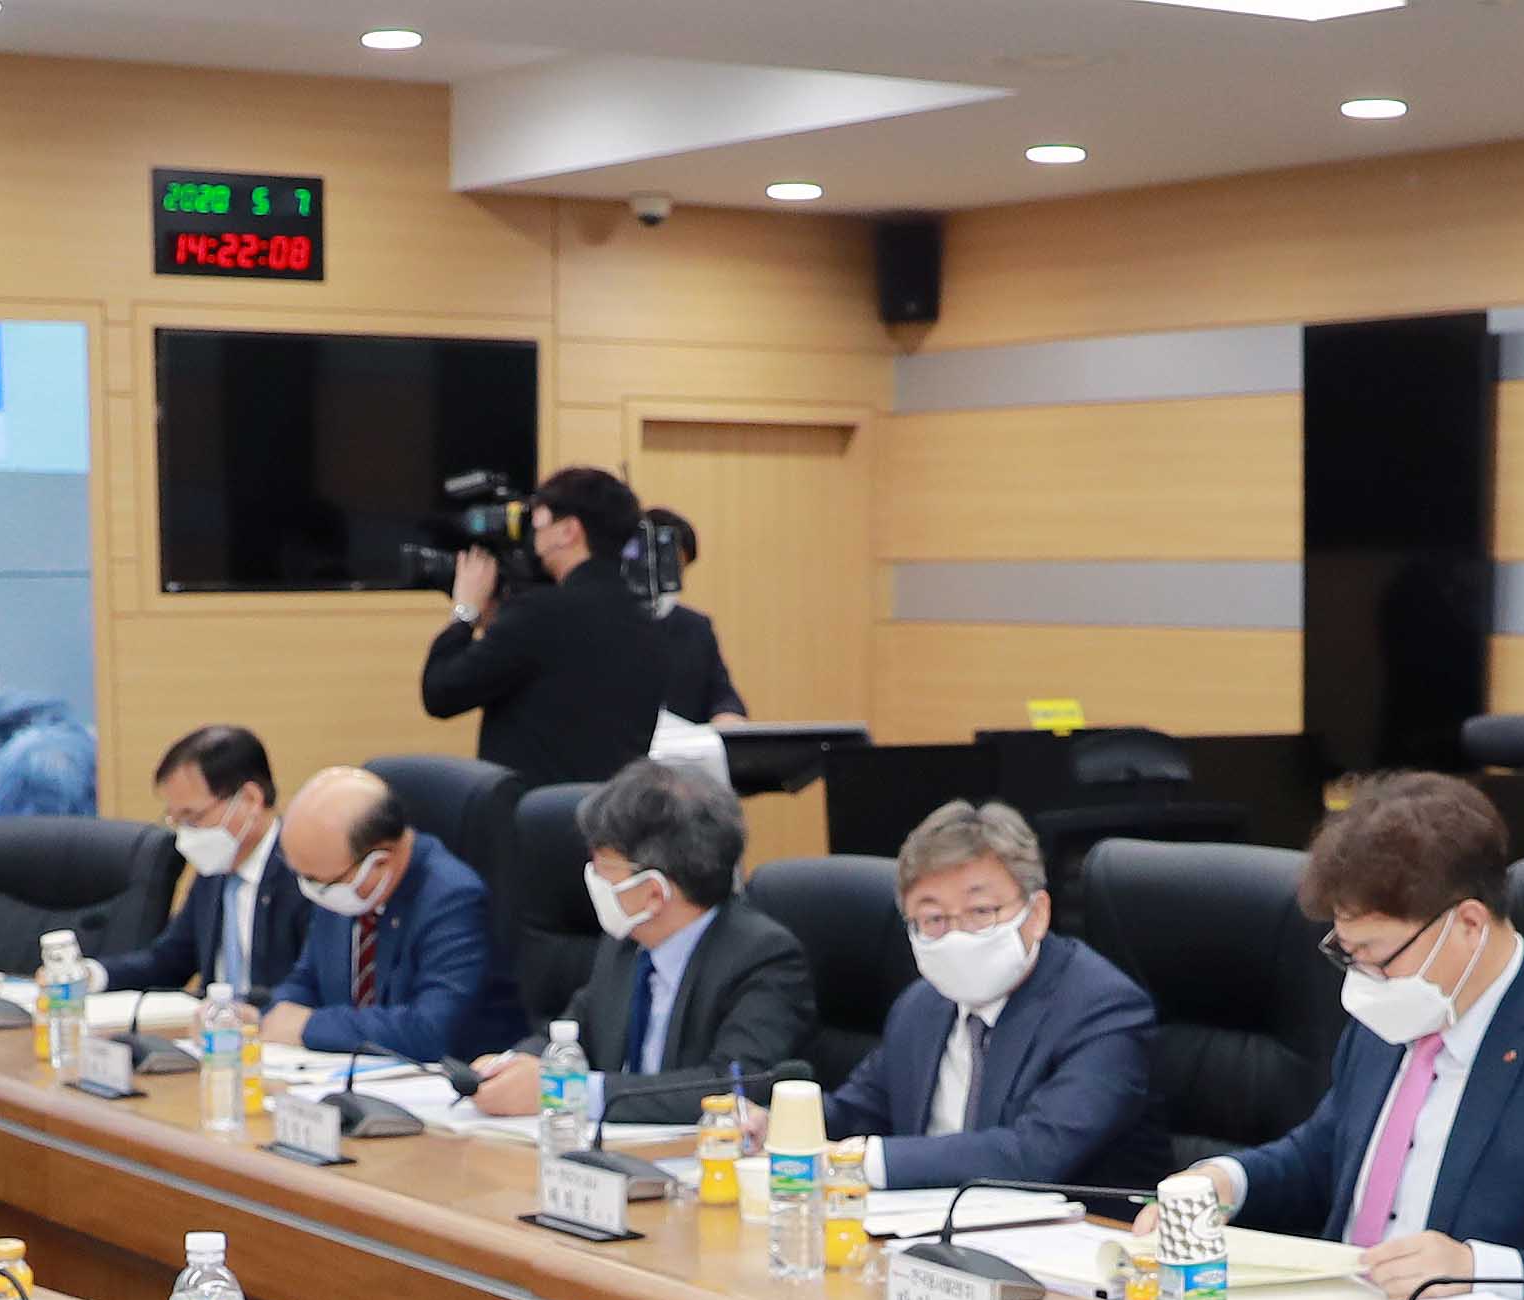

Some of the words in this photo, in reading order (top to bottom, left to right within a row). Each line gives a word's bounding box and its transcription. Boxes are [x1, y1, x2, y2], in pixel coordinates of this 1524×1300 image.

[251, 185, 270, 216] 5
[293, 187, 312, 217] 7
[175, 232, 313, 271] 14:22:08
